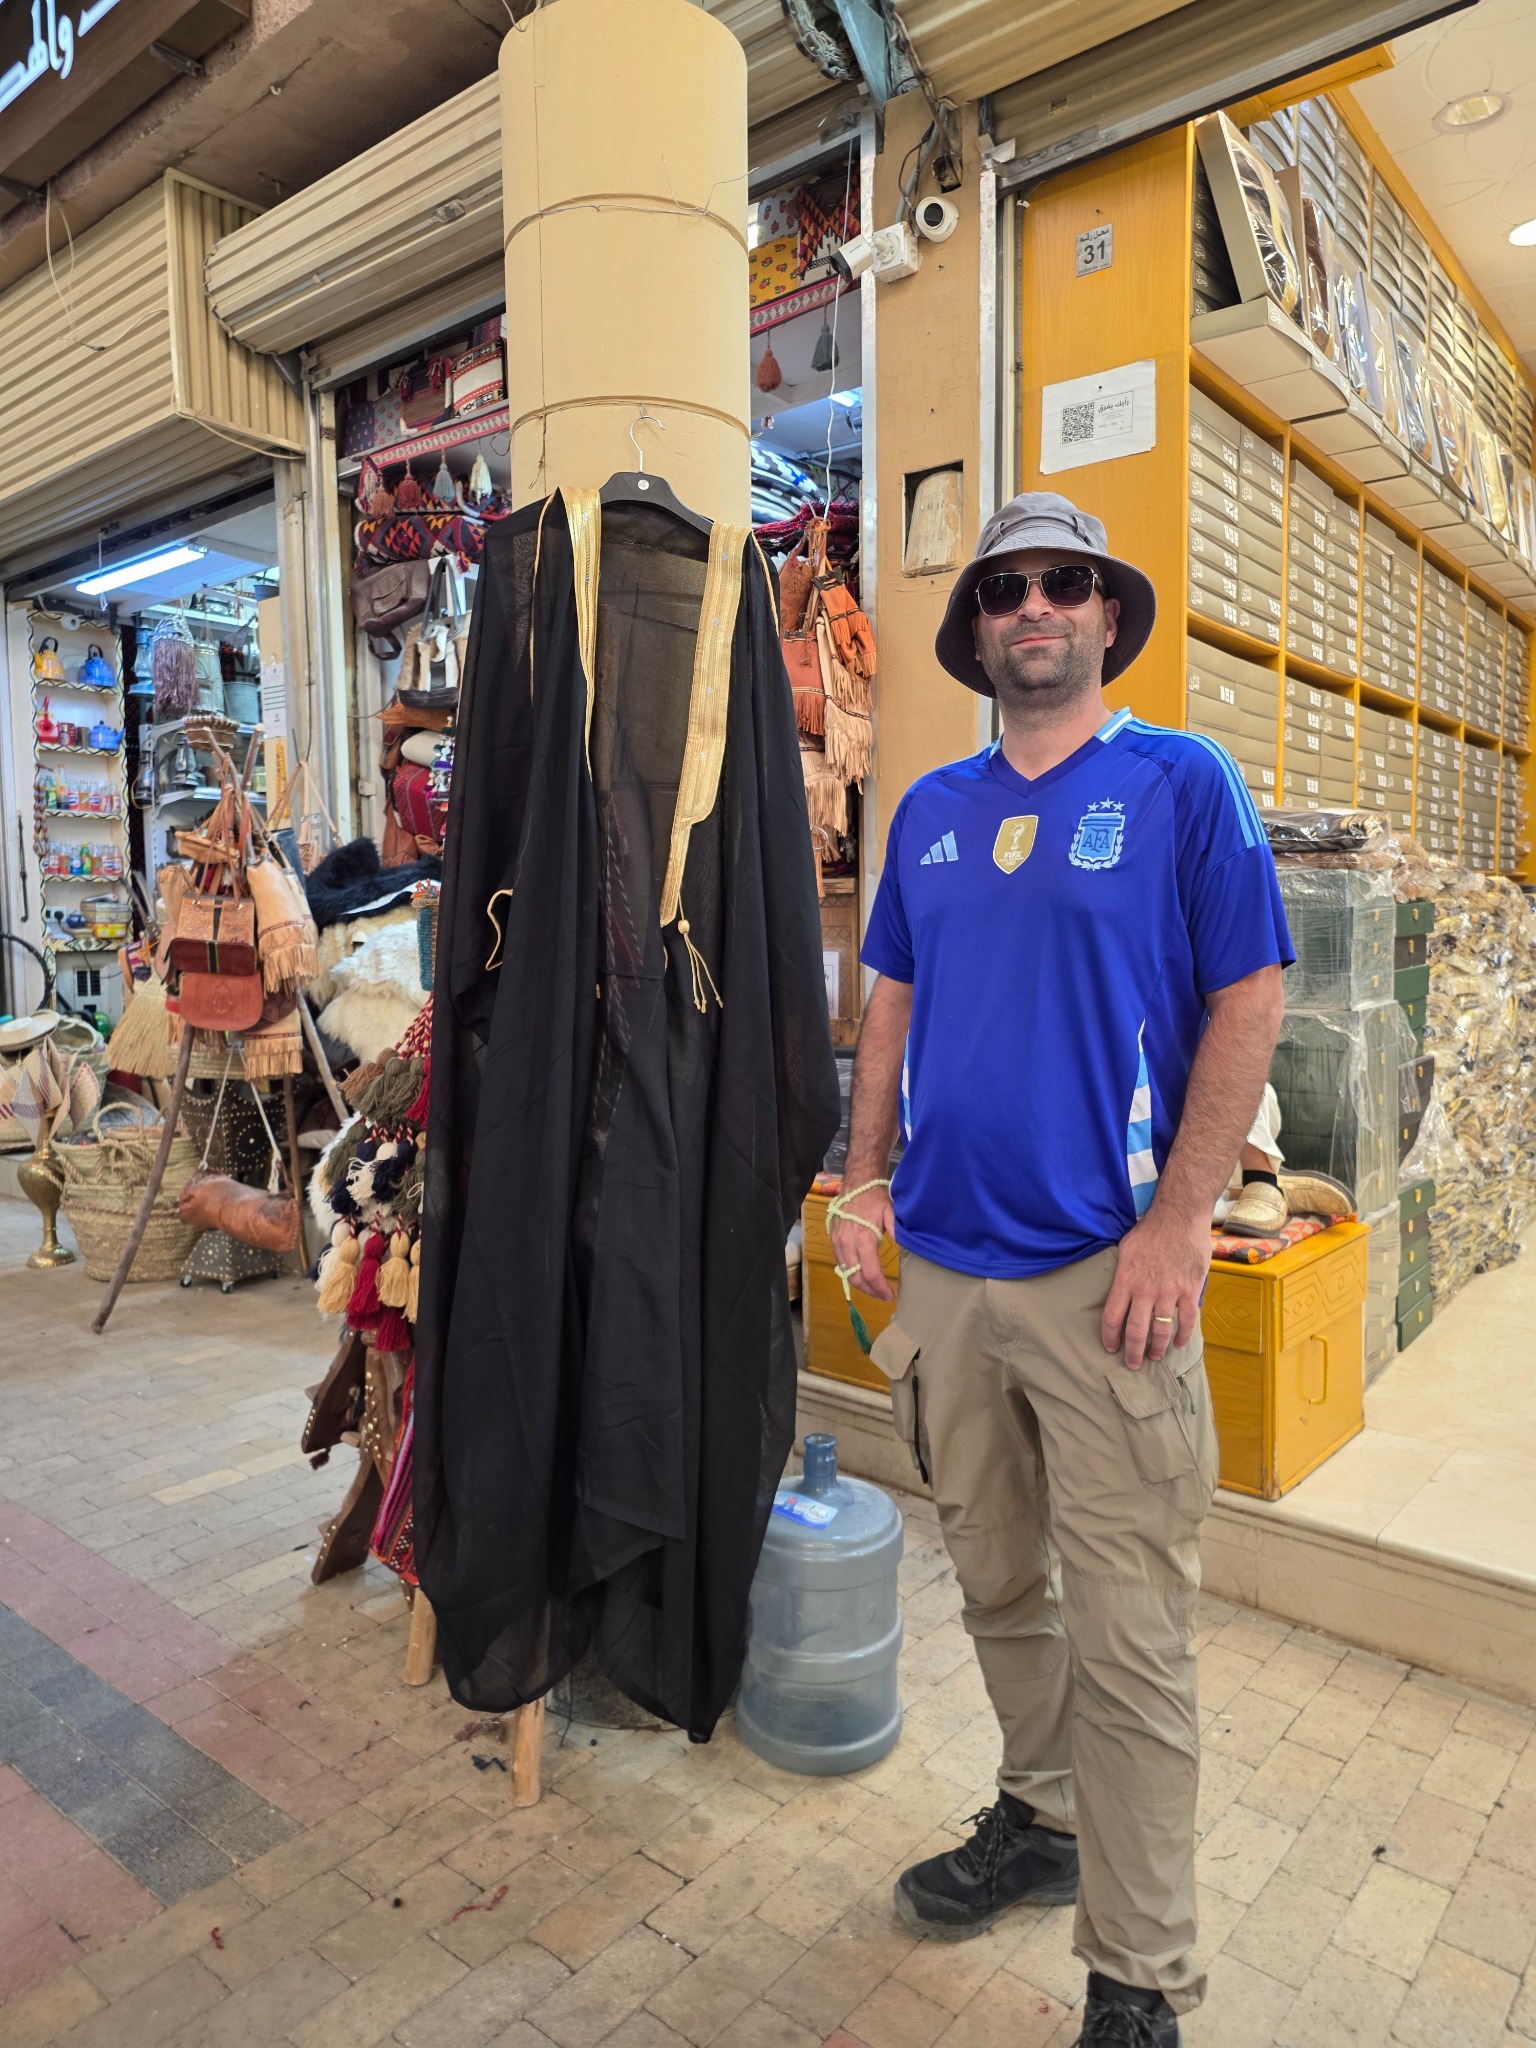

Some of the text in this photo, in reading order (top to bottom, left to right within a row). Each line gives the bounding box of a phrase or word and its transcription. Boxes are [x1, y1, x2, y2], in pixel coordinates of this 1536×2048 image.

[1079, 228, 1109, 243] محل رقم
[1083, 239, 1105, 265] 31
[1114, 396, 1130, 408] رأيك
[1081, 827, 1110, 853] AFA
[1003, 850, 1022, 860] FIFA
